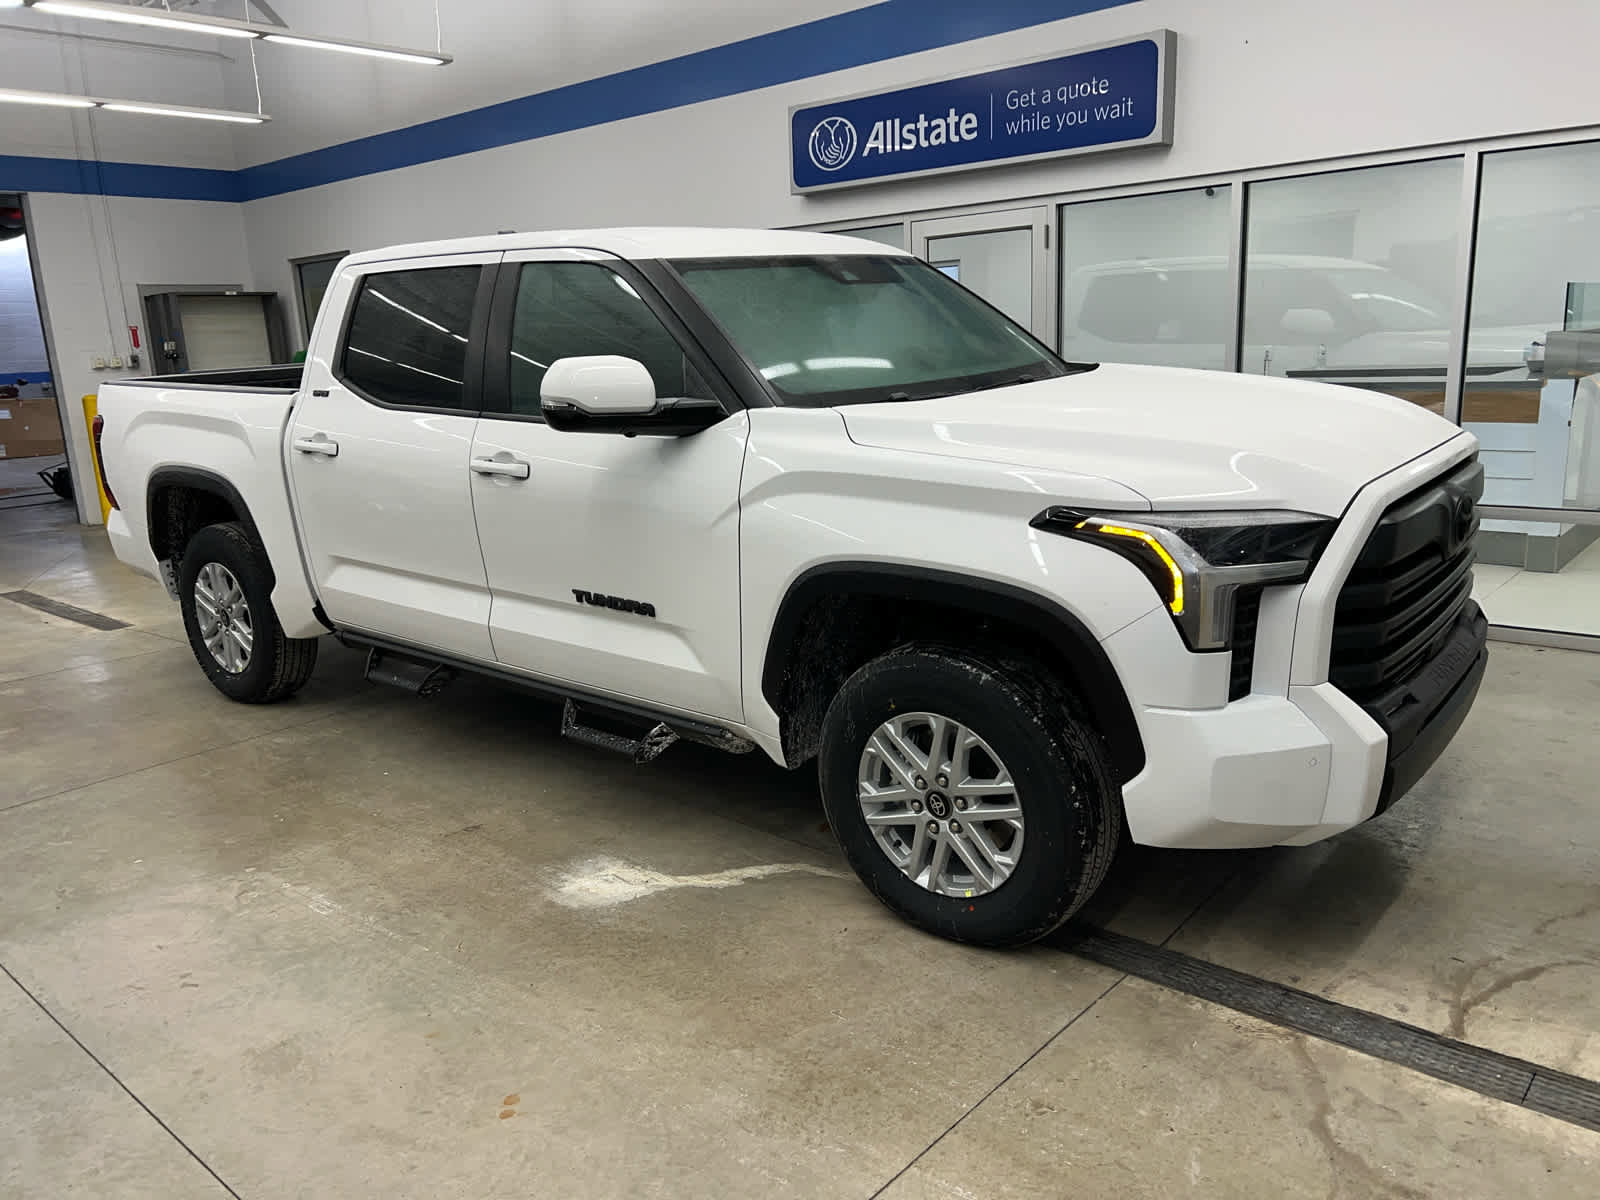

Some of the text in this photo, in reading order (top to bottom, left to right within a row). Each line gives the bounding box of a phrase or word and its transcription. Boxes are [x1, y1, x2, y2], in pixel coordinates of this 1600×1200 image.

[1006, 76, 1109, 110] Get a quote
[862, 108, 978, 156] Allstate
[1006, 97, 1134, 136] while you wait
[571, 588, 656, 617] TUNDRA
